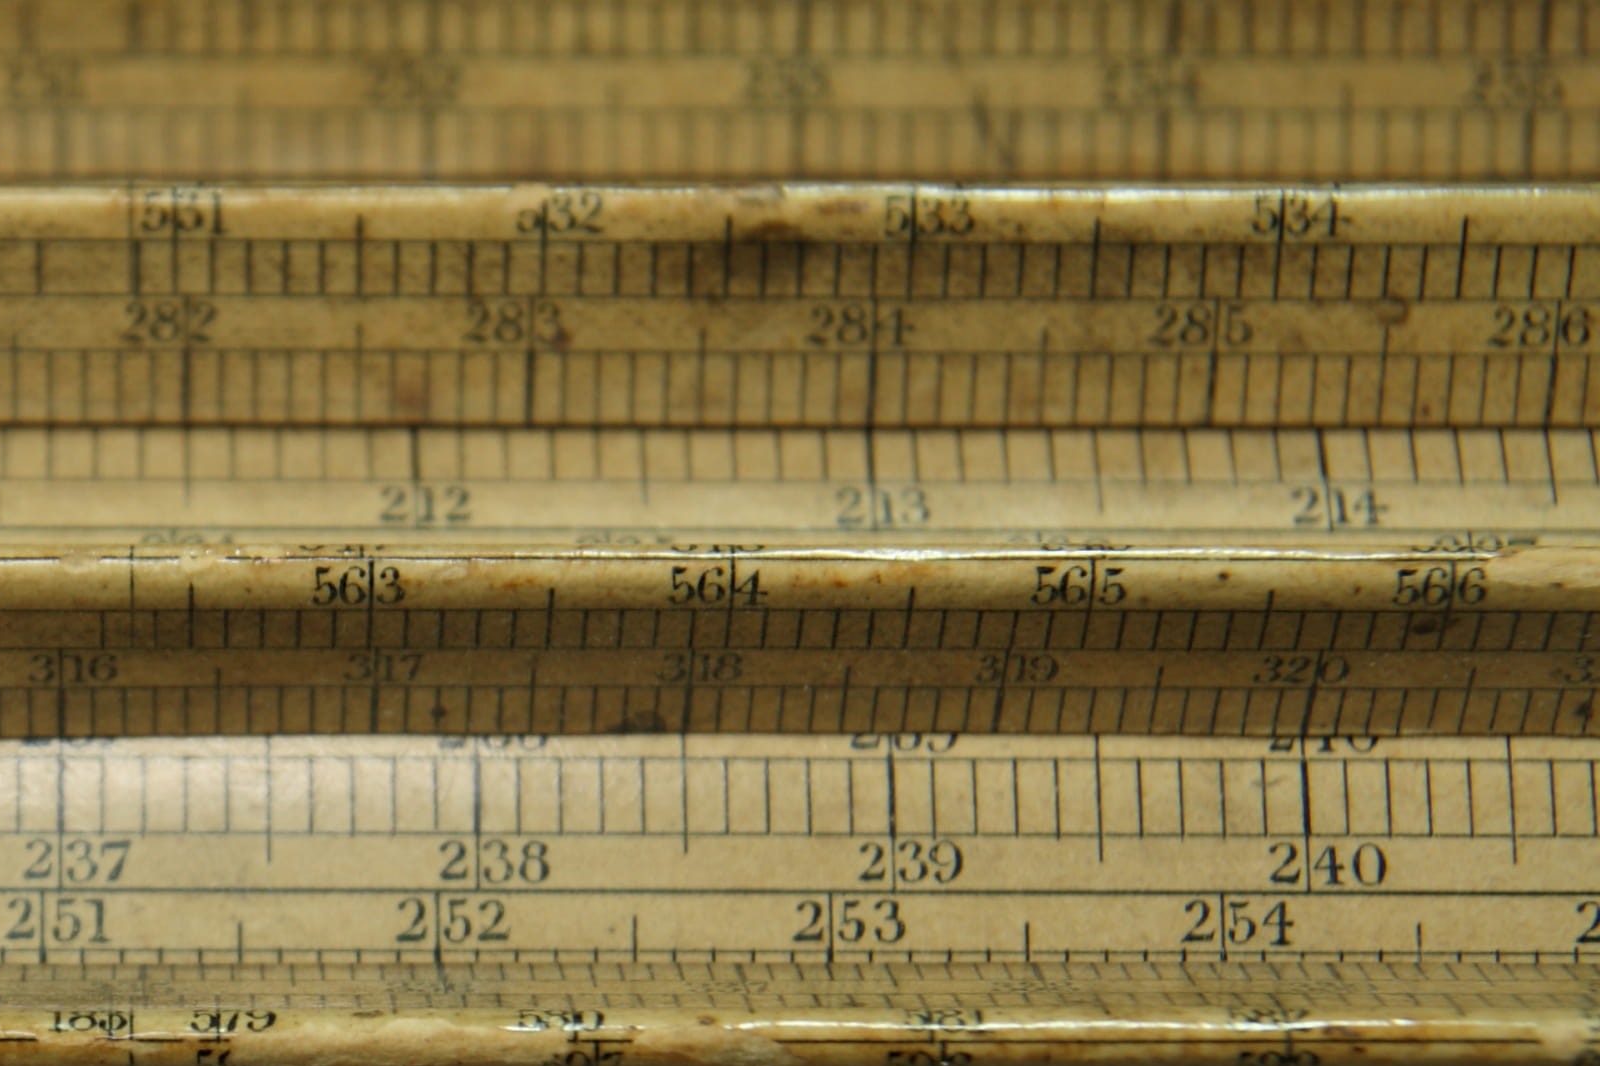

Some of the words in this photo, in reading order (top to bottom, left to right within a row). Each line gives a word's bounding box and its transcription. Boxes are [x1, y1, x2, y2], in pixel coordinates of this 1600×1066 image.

[884, 194, 975, 238] 533
[1251, 193, 1350, 238] 534
[123, 302, 218, 343] 282
[466, 303, 561, 343] 283
[809, 304, 913, 346] 284
[1150, 304, 1252, 346] 285
[1487, 305, 1591, 347] 286
[381, 485, 470, 523] 212
[836, 487, 930, 525] 213
[1292, 487, 1388, 527] 214
[312, 565, 407, 605] 563
[669, 566, 766, 607] 564
[1031, 566, 1127, 607] 565
[1394, 566, 1487, 607] 566
[30, 654, 118, 684] 316
[343, 654, 423, 683] 317
[656, 653, 743, 683] 318
[976, 654, 1058, 684] 319
[1255, 655, 1351, 685] 320
[24, 839, 132, 882] 237
[439, 839, 550, 882] 238
[858, 840, 964, 883] 239
[1269, 842, 1388, 886] 240
[5, 899, 110, 942] 251
[397, 899, 511, 942] 252
[792, 900, 906, 943] 253
[1182, 901, 1295, 945] 254
